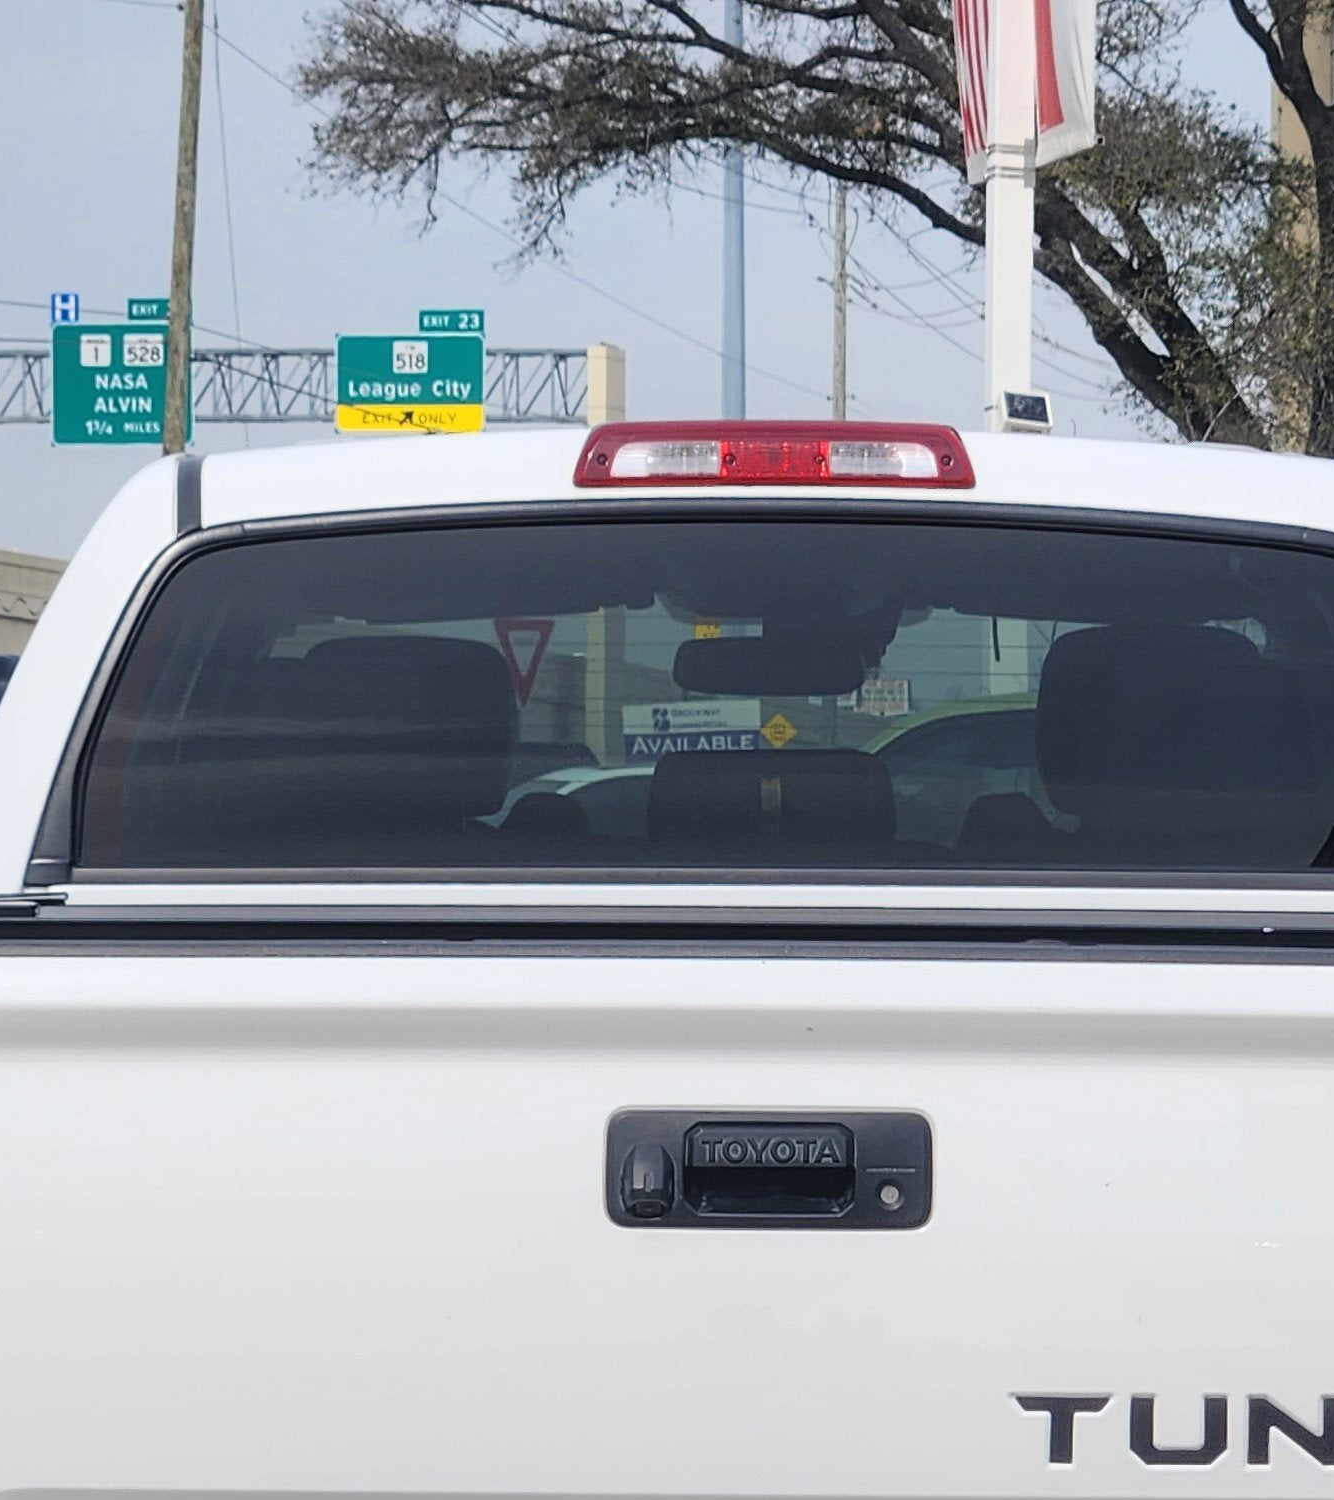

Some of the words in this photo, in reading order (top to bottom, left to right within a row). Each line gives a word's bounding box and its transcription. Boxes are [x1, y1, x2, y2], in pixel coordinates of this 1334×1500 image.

[131, 304, 158, 316] EXIT
[423, 315, 449, 327] EXIT
[458, 313, 480, 329] 23
[93, 347, 99, 362] 1
[127, 346, 161, 363] 528
[396, 353, 426, 370] 518
[94, 373, 148, 390] NASA
[348, 380, 422, 402] League
[432, 379, 472, 400] City
[94, 397, 153, 413] ALVIN
[419, 413, 457, 424] ONLY
[123, 422, 161, 433] MILES
[632, 735, 755, 754] AVAILABLE
[701, 1137, 841, 1164] TOYOTA
